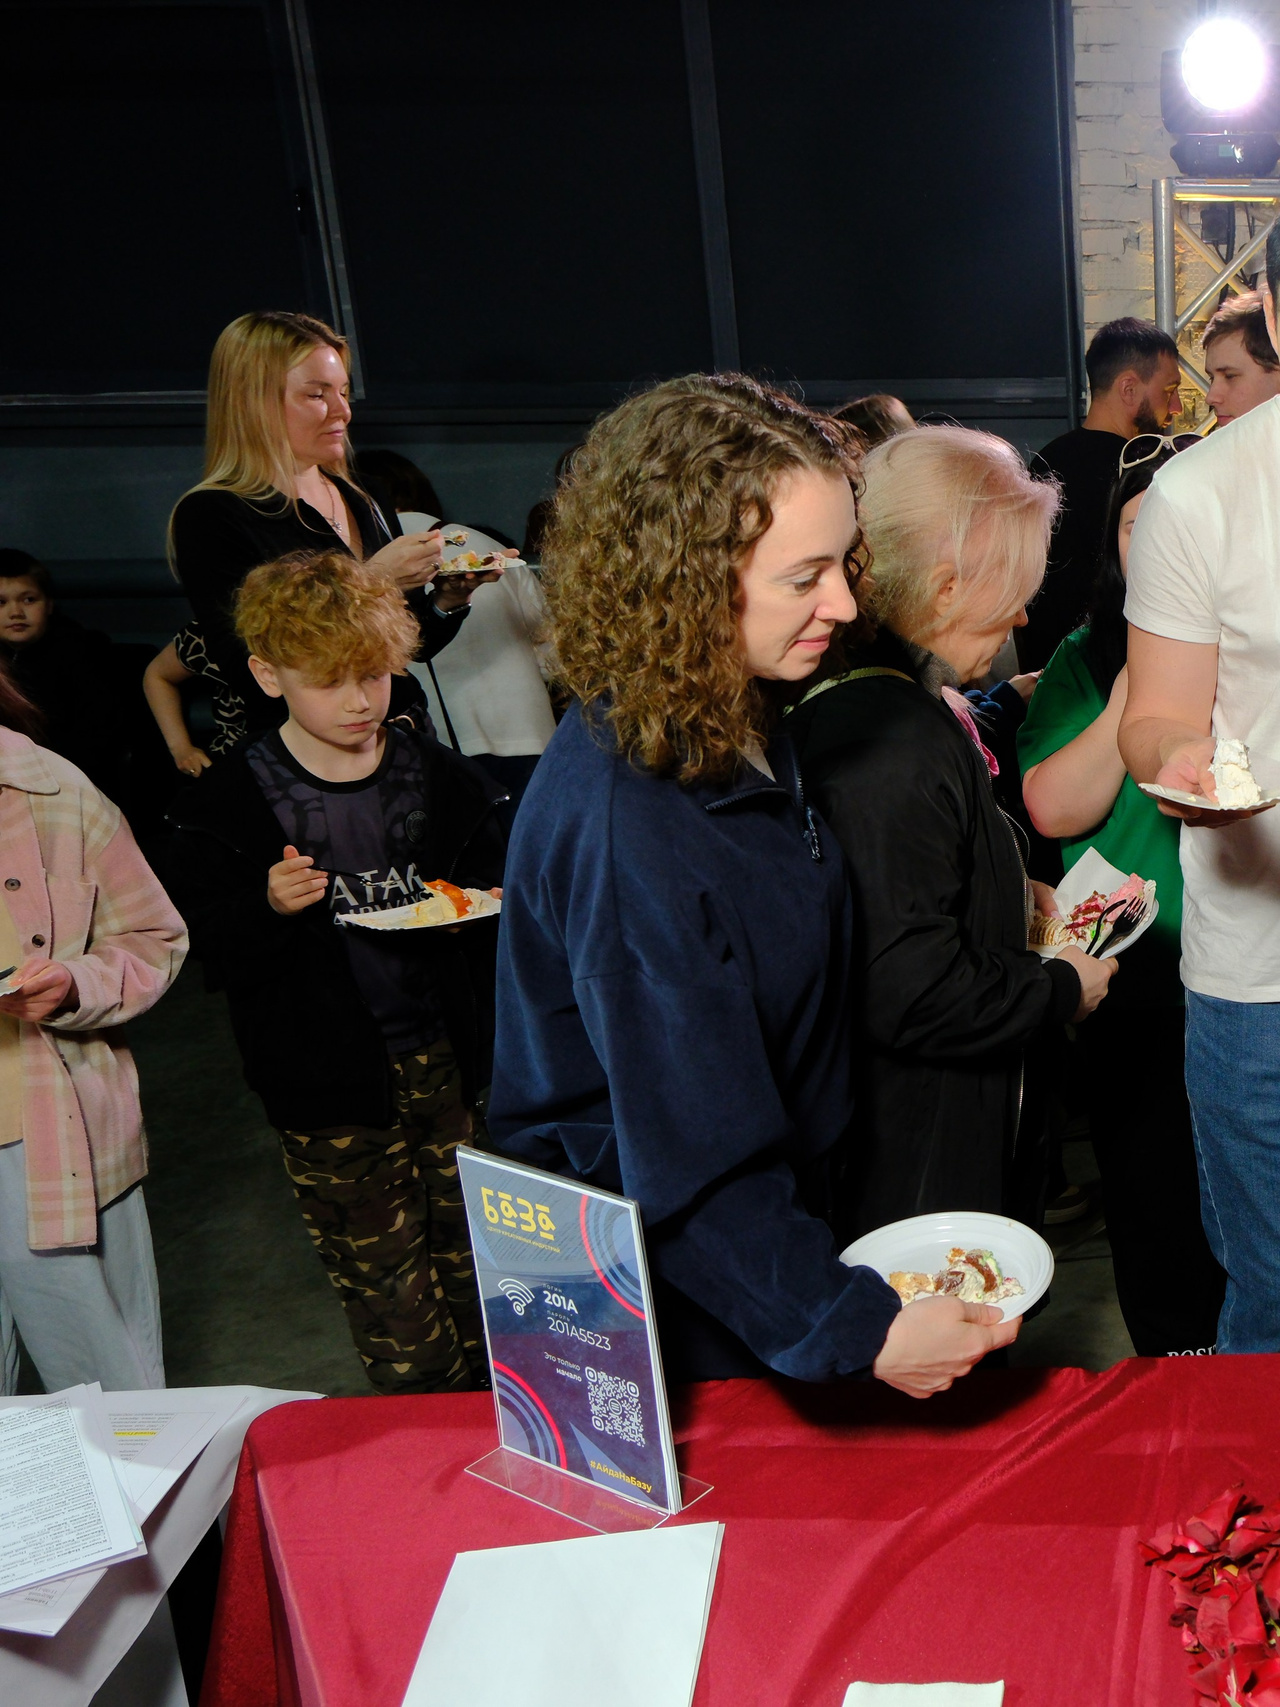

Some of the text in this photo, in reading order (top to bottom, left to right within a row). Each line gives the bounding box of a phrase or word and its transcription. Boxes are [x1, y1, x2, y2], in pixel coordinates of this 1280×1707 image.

[329, 863, 426, 910] ATAR
[543, 1290, 578, 1314] 201A
[546, 1310, 570, 1322] ПАРОЛЬ
[547, 1317, 611, 1351] 201A5523
[544, 1351, 581, 1371] Это только
[556, 1368, 582, 1382] начало
[590, 1460, 652, 1493] #АйдаНаБазу
